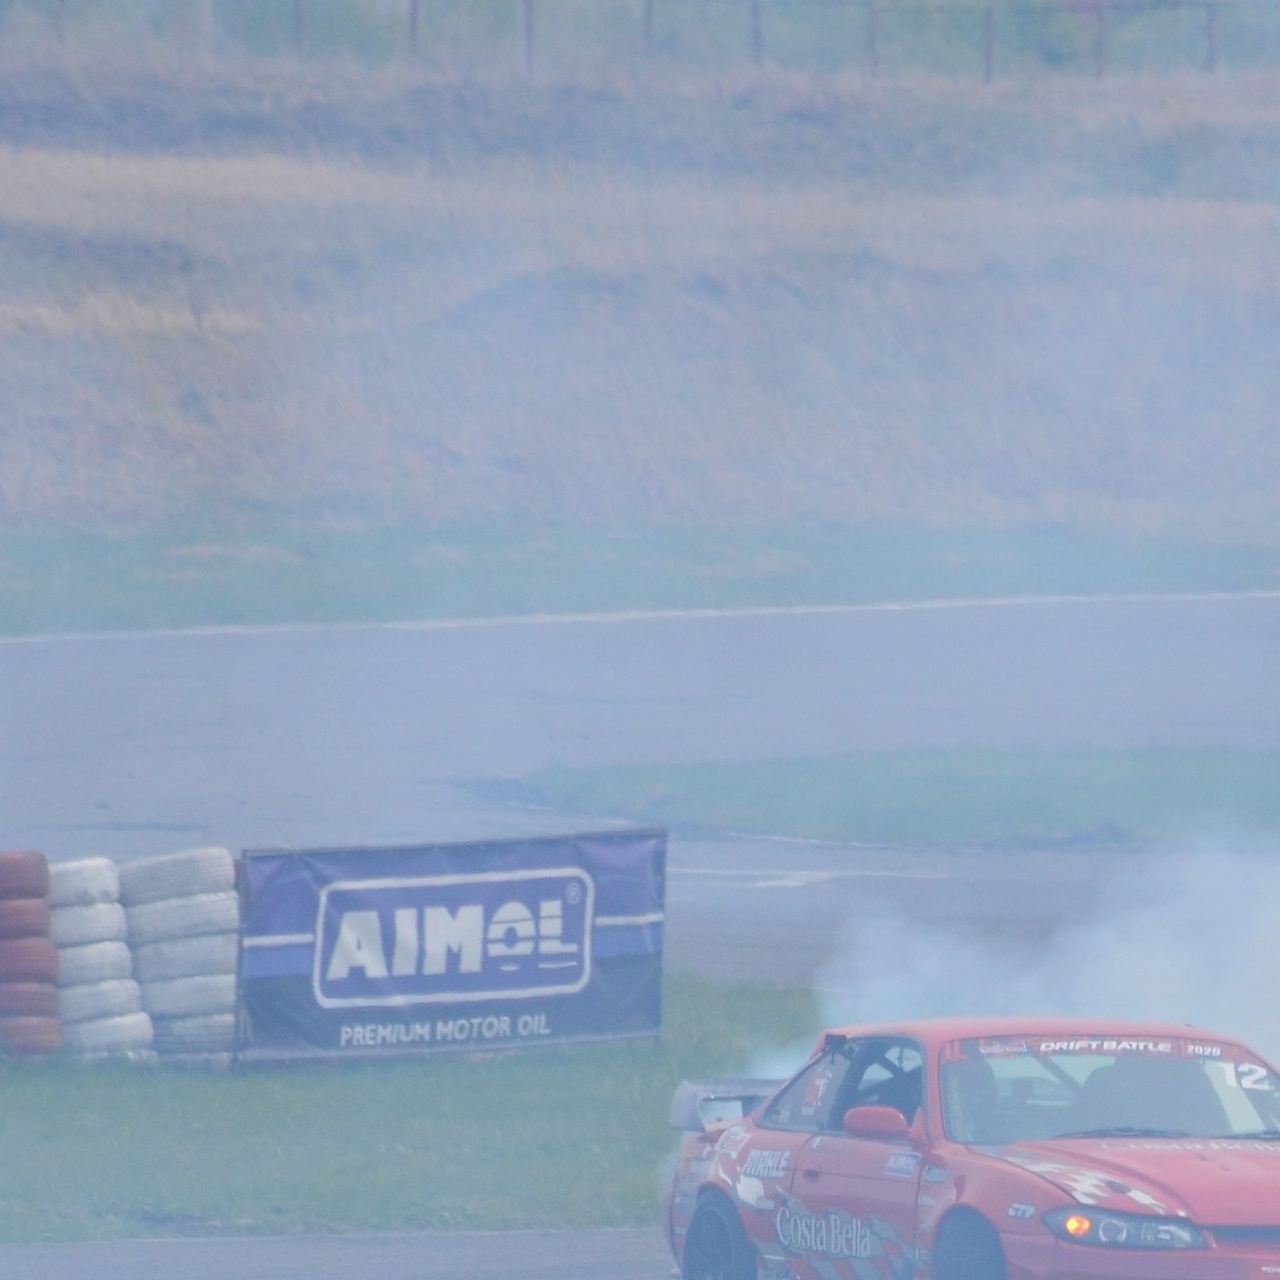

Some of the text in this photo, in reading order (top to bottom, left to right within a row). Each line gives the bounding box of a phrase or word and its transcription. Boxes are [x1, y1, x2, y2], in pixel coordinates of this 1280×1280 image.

[326, 900, 578, 982] AIMOL
[340, 1016, 552, 1047] PREMIUM MOTOR OIL
[1039, 1040, 1101, 1052] DRIFT
[1103, 1040, 1172, 1053] BATTLE
[1218, 1062, 1271, 1091] 12
[741, 1149, 791, 1178] MAHLE
[776, 1206, 871, 1258] Costa Bella
